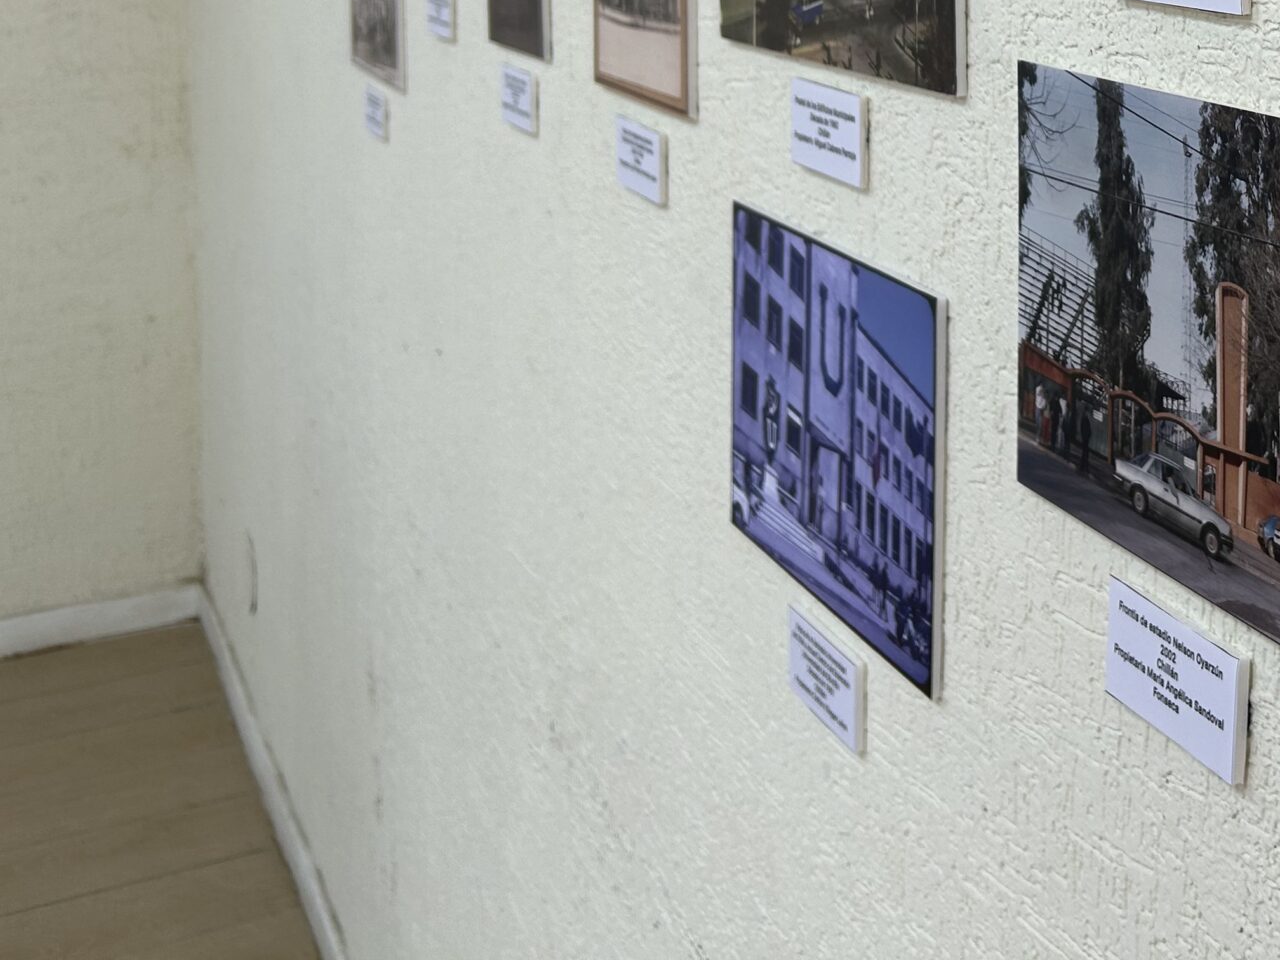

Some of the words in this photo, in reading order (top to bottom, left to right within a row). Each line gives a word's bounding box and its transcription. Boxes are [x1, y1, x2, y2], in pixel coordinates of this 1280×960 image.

[1118, 600, 1139, 622] Frontis
[1140, 616, 1148, 628] de
[1149, 621, 1171, 645] estadio
[1173, 636, 1195, 661] Nelson
[1196, 653, 1224, 680] Oyarzún
[1160, 645, 1176, 664] 2002
[1156, 658, 1179, 681] Chillán
[1114, 642, 1146, 674] Propietaria
[1147, 666, 1164, 688] María
[1166, 678, 1193, 708] Angélica
[1194, 699, 1225, 731] Sandoval
[1153, 686, 1180, 714] Fonseca
